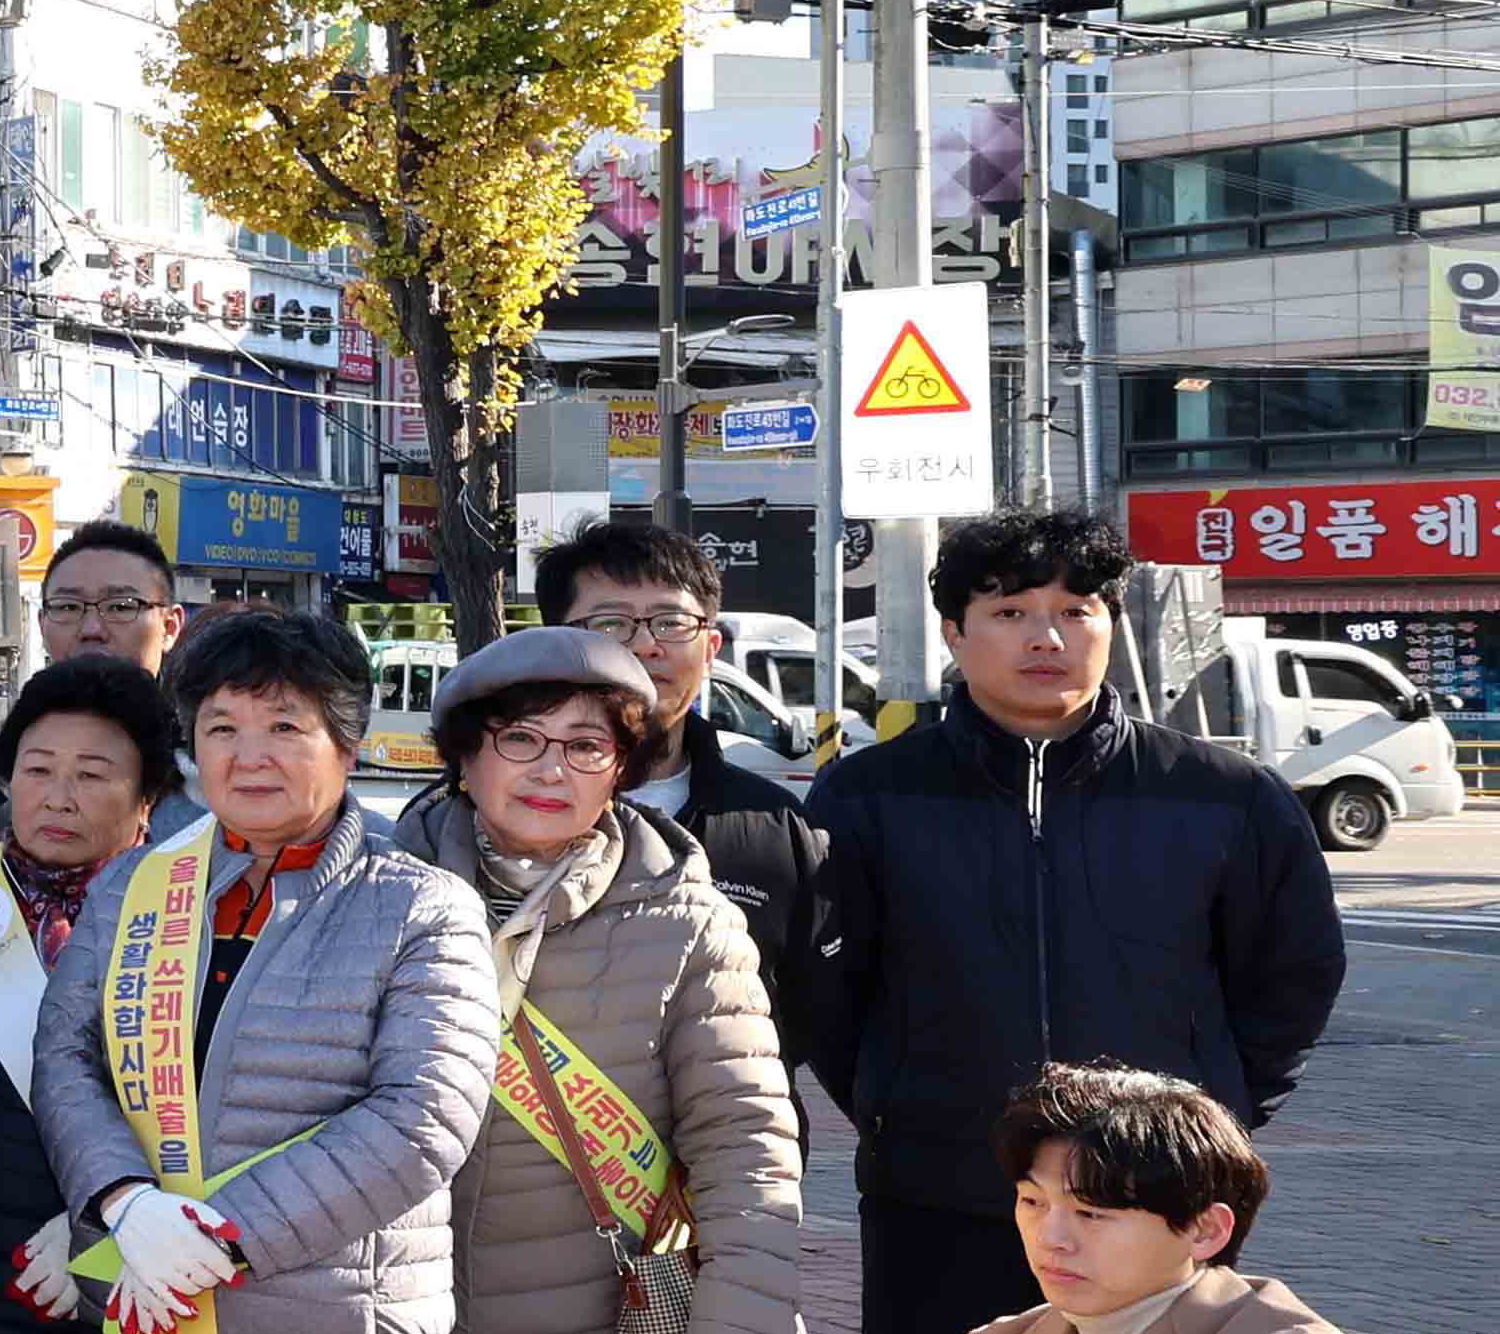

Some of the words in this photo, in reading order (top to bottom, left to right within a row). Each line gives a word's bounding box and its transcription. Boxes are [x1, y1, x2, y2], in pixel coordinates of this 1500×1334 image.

[856, 454, 975, 483] 우회전시
[228, 489, 301, 543] 영화마을
[1250, 499, 1388, 562] 일품
[1411, 492, 1500, 558] 해
[1345, 619, 1400, 642] 영업중
[160, 854, 200, 945] 올바른
[112, 911, 160, 1116] 생활화합시다
[150, 960, 191, 1176] 쓰레기배출을
